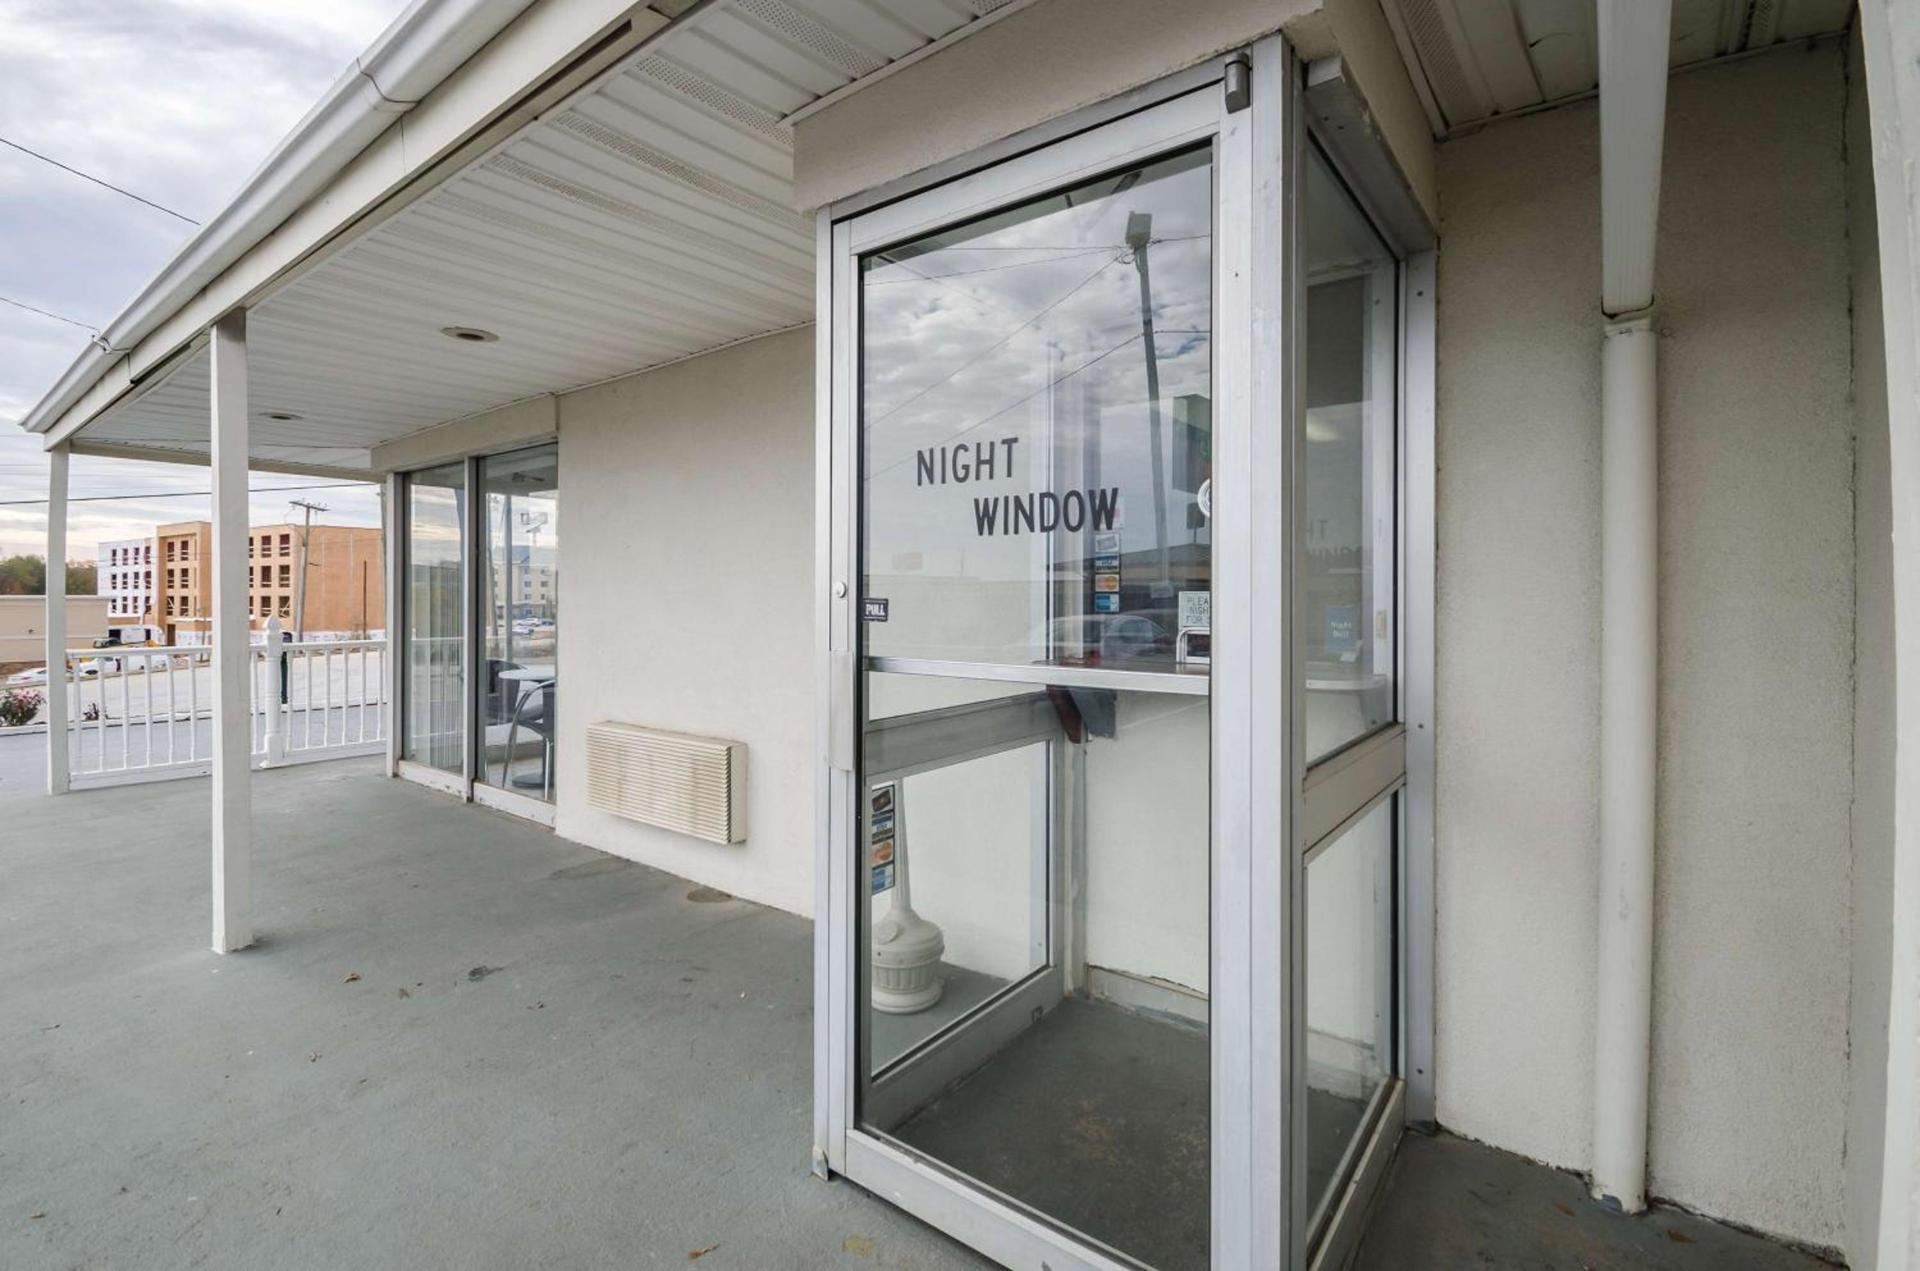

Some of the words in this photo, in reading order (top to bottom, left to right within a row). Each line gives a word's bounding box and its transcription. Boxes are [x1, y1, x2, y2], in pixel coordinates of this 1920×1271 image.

[916, 436, 1019, 487] NIGHT
[973, 487, 1119, 536] WINDOW
[1186, 595, 1209, 606] PLEA
[865, 603, 886, 616] PULL
[1189, 606, 1209, 615] NIGH
